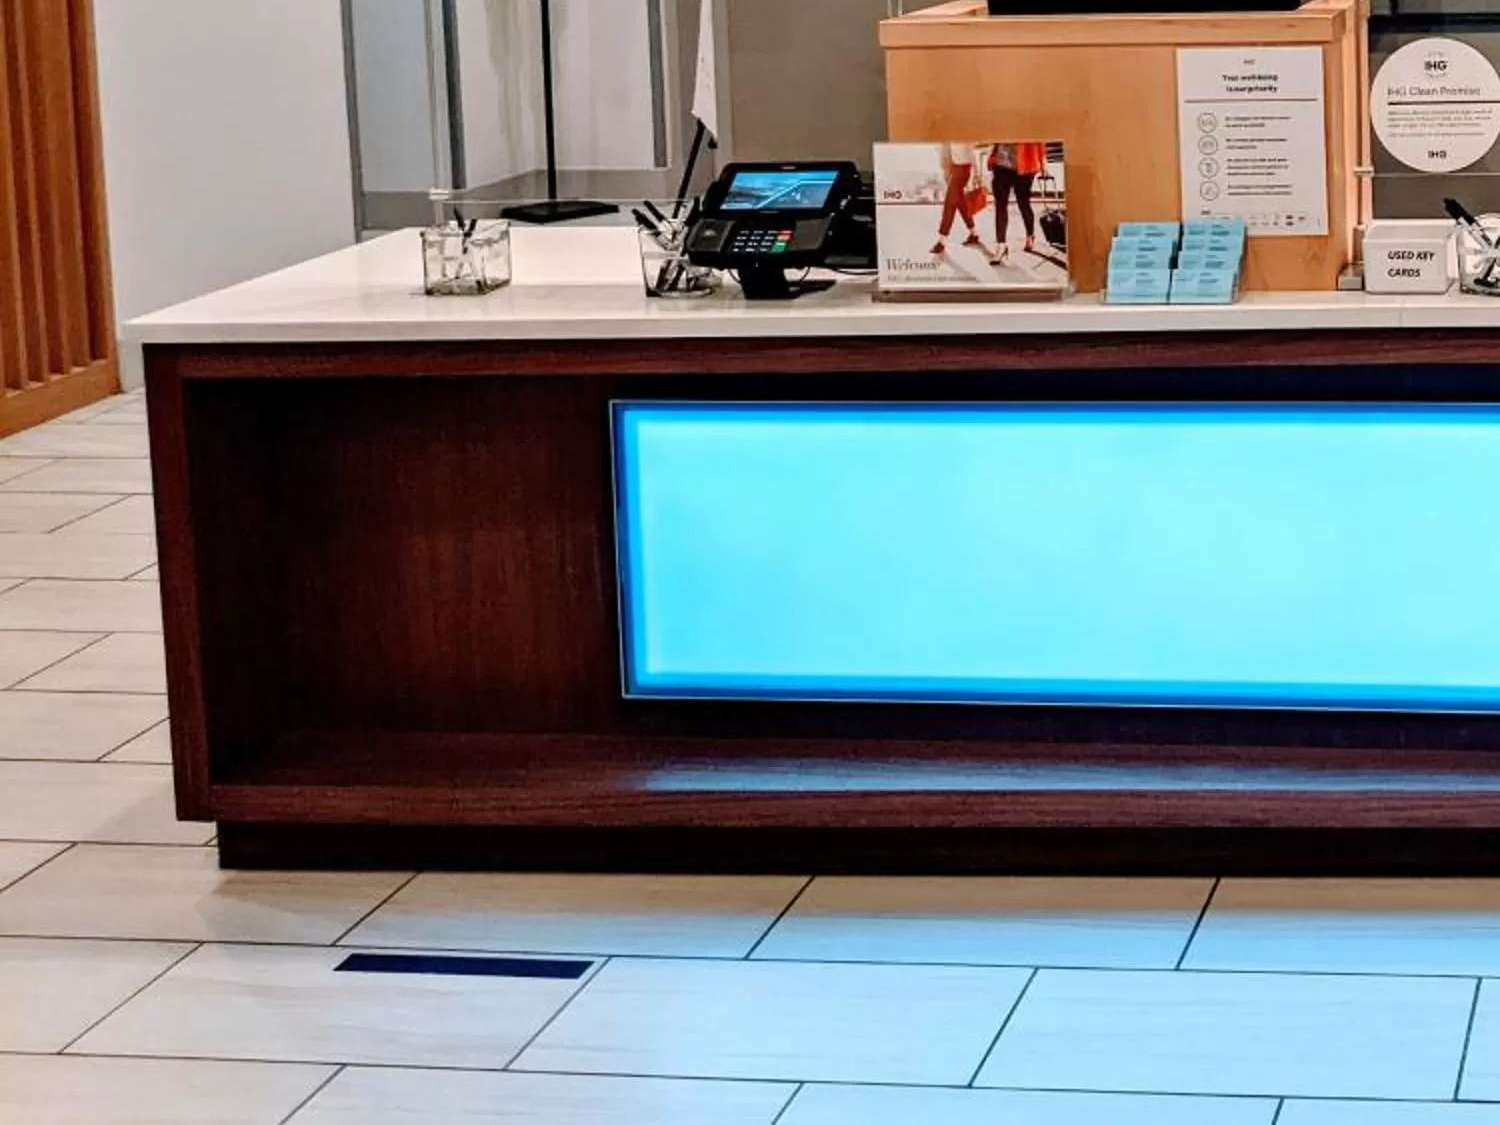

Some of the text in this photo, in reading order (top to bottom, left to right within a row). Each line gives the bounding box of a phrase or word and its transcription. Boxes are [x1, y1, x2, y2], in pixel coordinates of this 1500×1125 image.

[1424, 60, 1448, 71] IHG
[1387, 86, 1407, 96] IHG
[1409, 86, 1438, 96] Clean
[1427, 150, 1447, 158] IHG
[1387, 250, 1436, 261] USED KEY
[1387, 268, 1421, 278] CARDS
